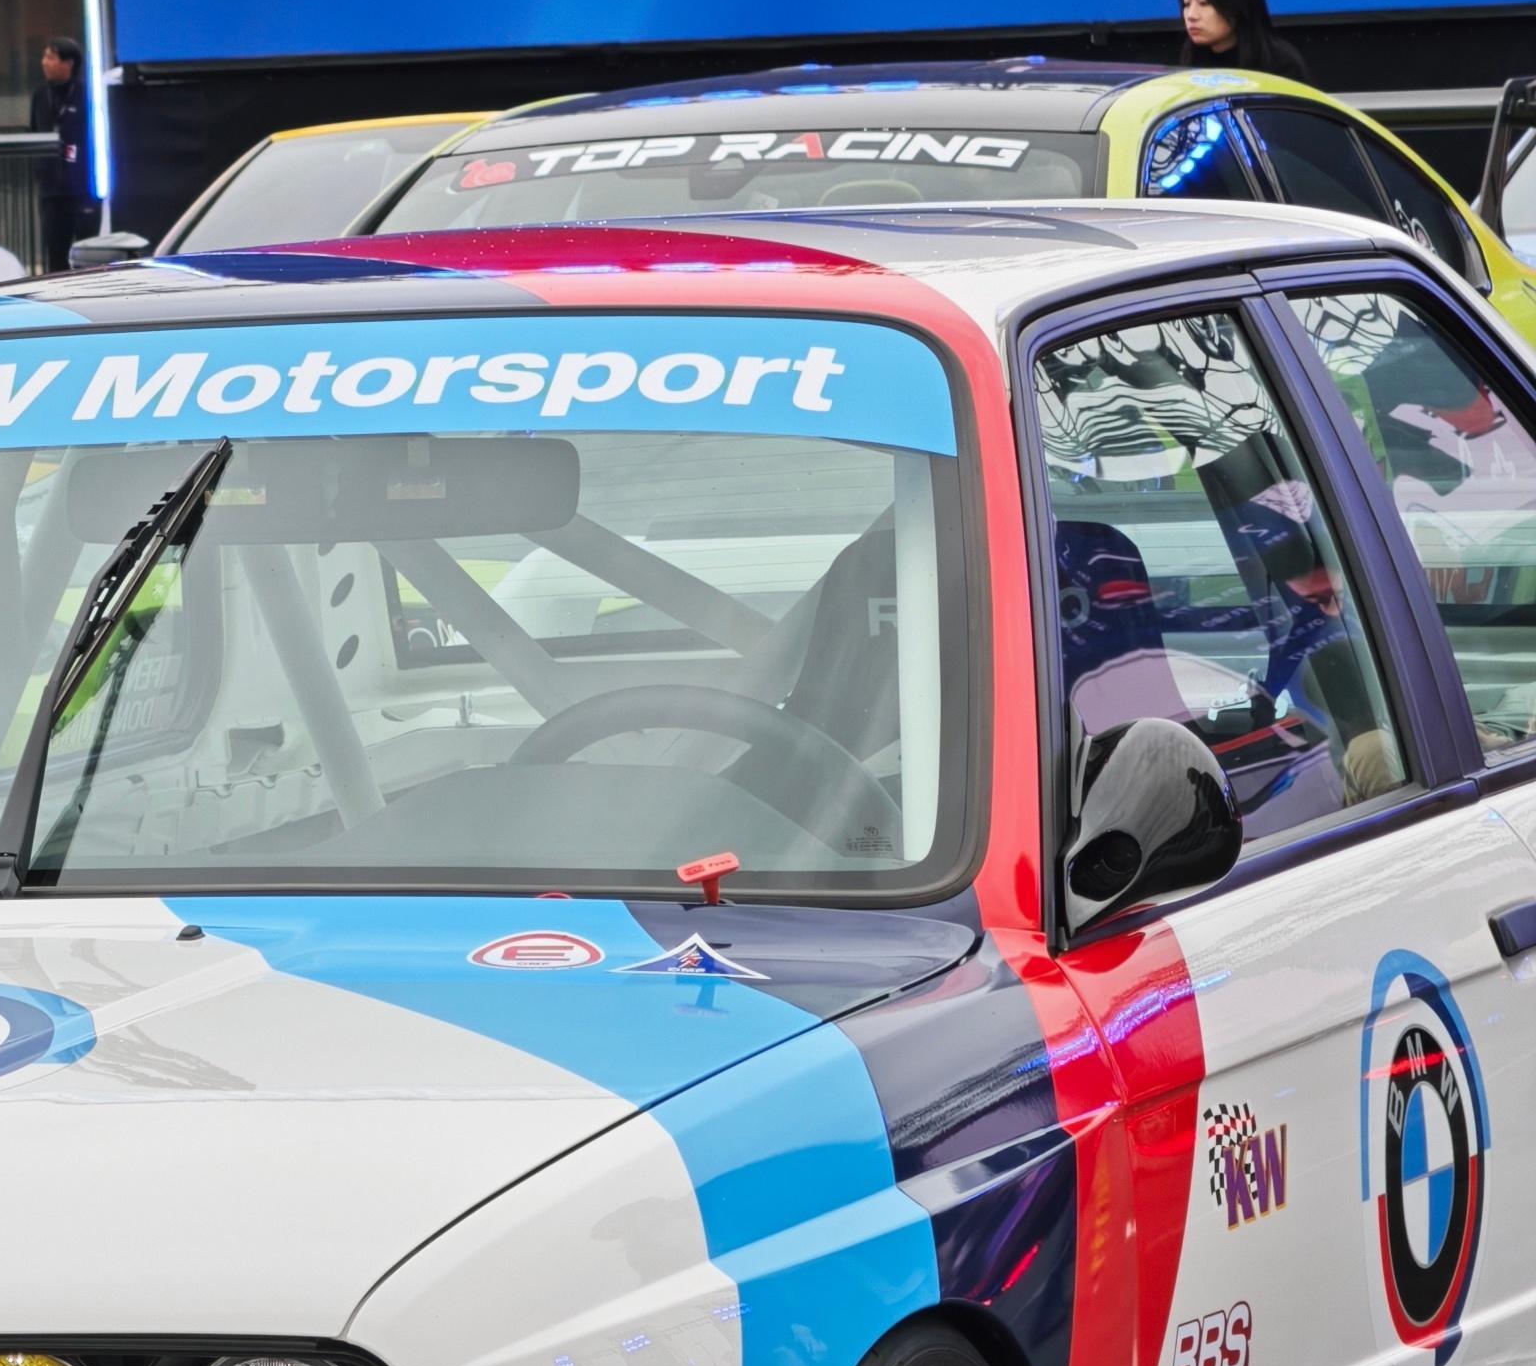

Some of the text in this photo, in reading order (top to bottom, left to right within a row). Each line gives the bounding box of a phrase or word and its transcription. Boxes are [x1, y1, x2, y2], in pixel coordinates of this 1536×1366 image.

[529, 132, 1030, 177] TOP RACING
[71, 346, 845, 422] Motorsport
[1387, 1032, 1461, 1136] BMW
[1221, 1123, 1288, 1232] KW
